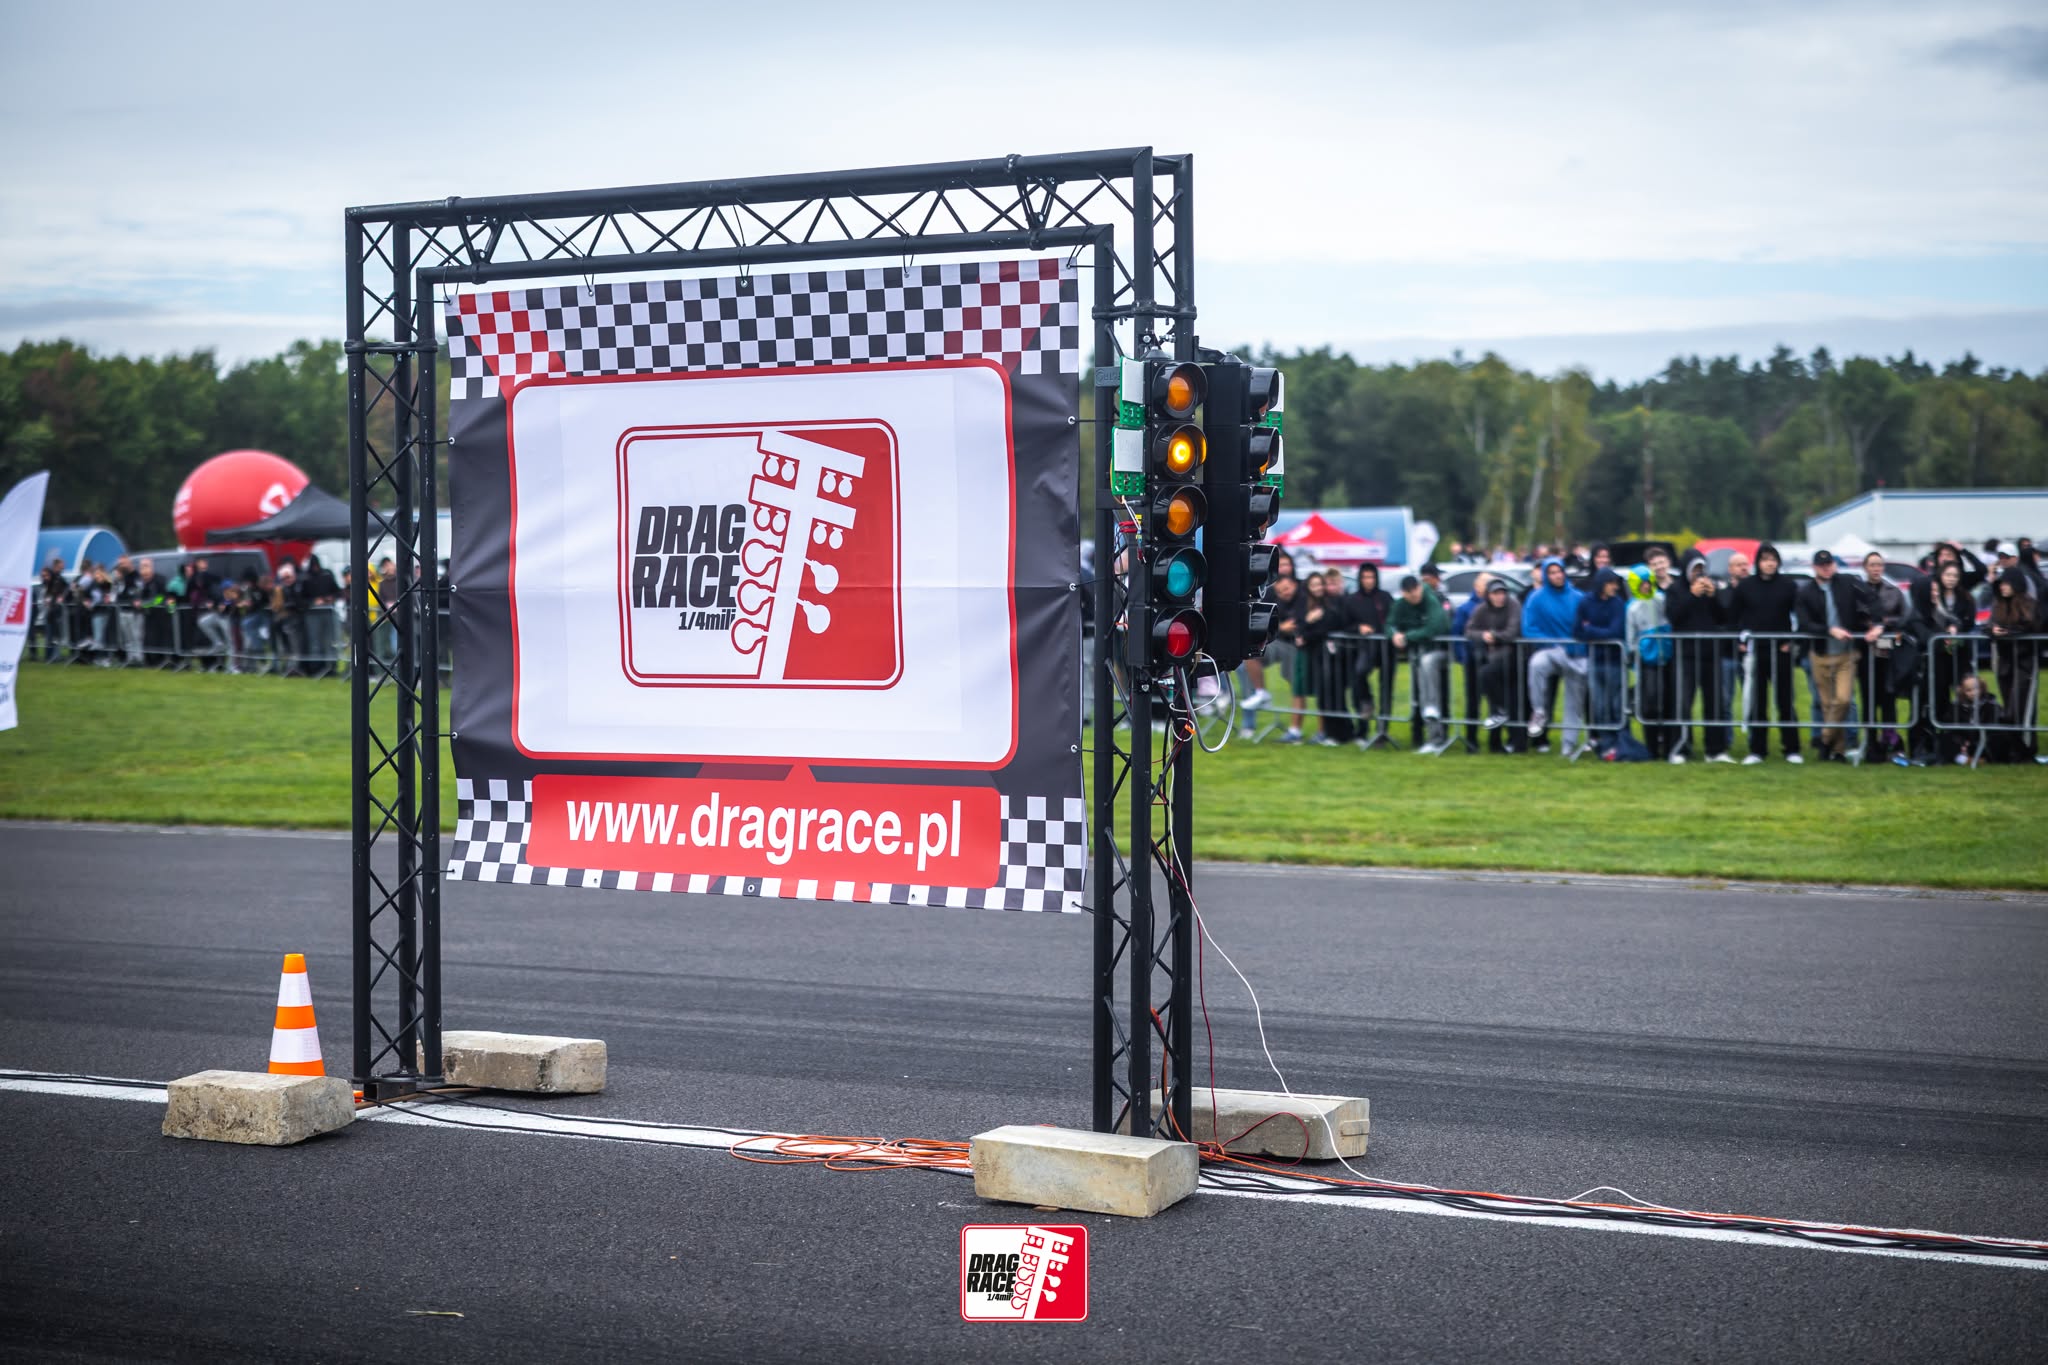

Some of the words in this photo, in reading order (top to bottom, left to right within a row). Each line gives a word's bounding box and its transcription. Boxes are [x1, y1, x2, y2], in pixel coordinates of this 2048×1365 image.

[635, 504, 747, 554] DRAG
[632, 555, 741, 608] RACE
[566, 791, 962, 872] www.dragrace.pl
